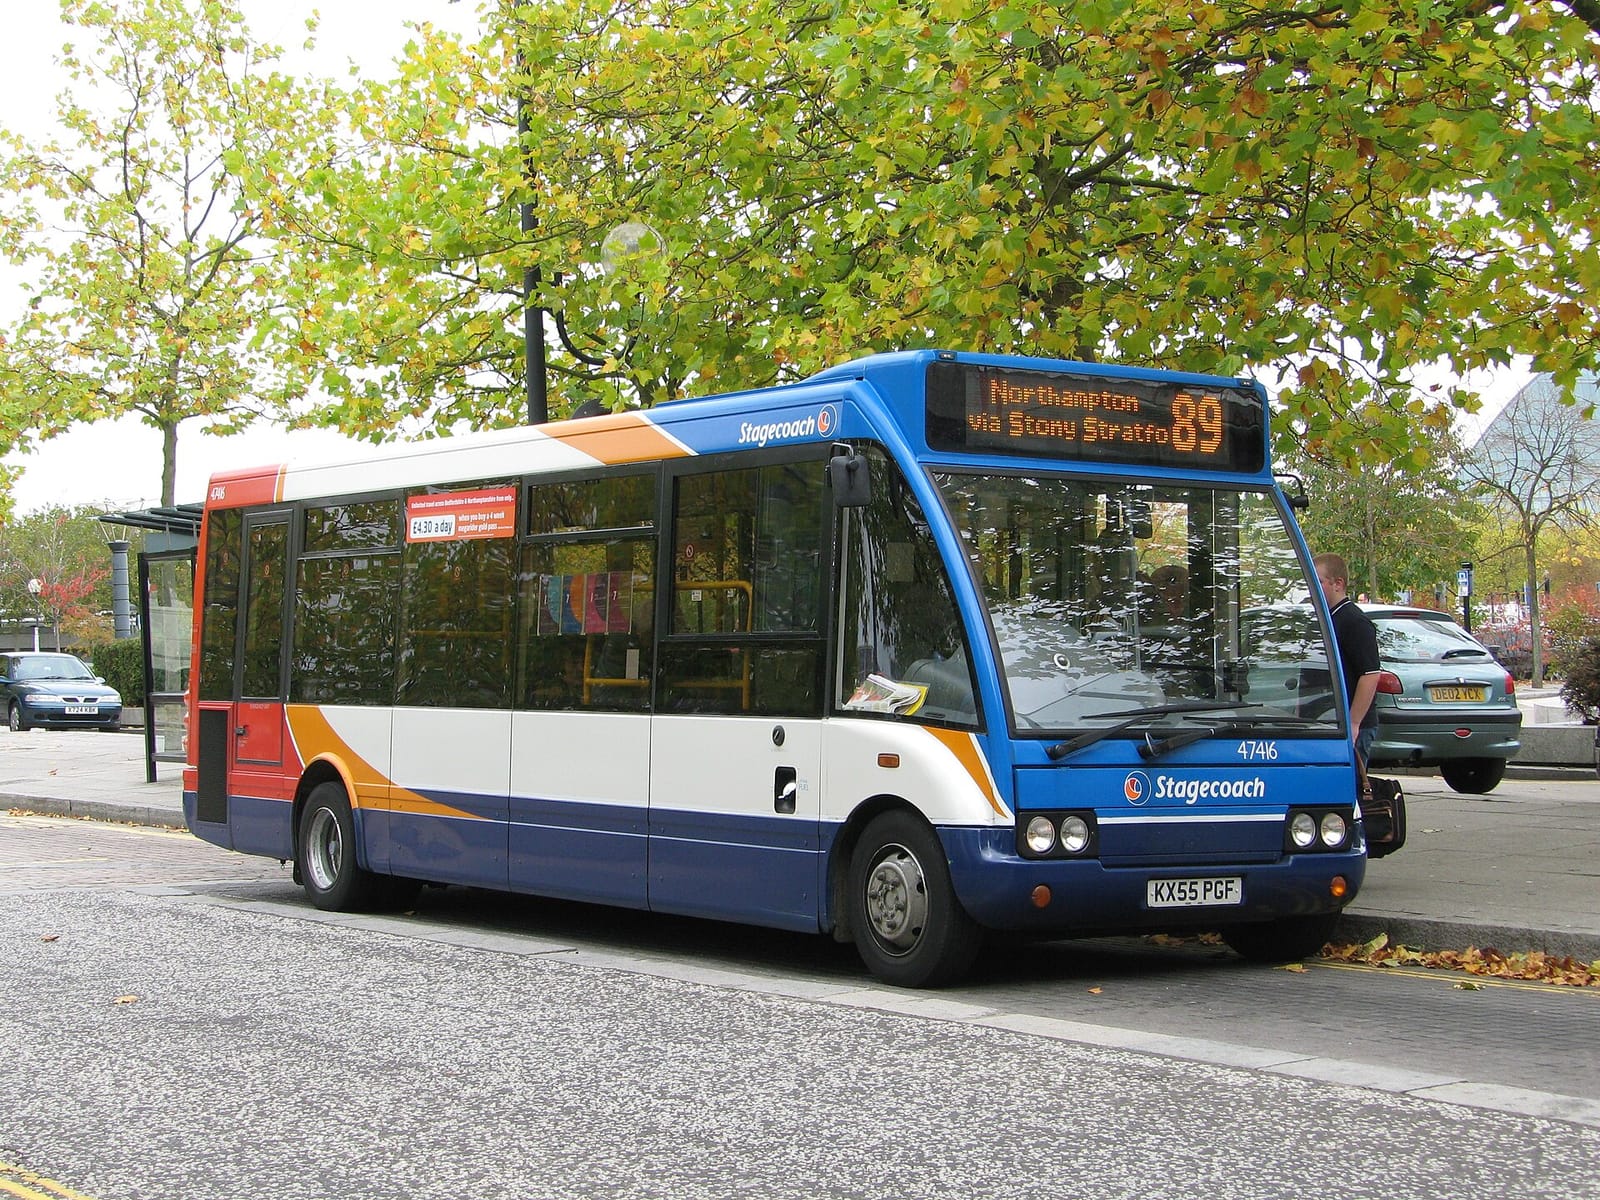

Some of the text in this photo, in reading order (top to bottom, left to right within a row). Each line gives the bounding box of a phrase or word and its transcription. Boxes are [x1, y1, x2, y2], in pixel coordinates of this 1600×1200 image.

[990, 378, 1139, 413] Northampton
[738, 415, 816, 448] Stagecoach
[968, 413, 1001, 433] via
[1008, 411, 1077, 441] Stony
[1171, 391, 1223, 454] 89
[413, 519, 453, 535] £4.30 a day
[459, 514, 470, 522] when
[470, 513, 478, 522] you
[478, 512, 486, 522] buy
[478, 522, 487, 533] gold
[487, 523, 498, 532] pass
[1435, 687, 1480, 700] DE02 YCX
[1237, 741, 1278, 761] 47416
[1155, 775, 1265, 805] Stagecoach
[1154, 879, 1235, 903] KX55 PGF
